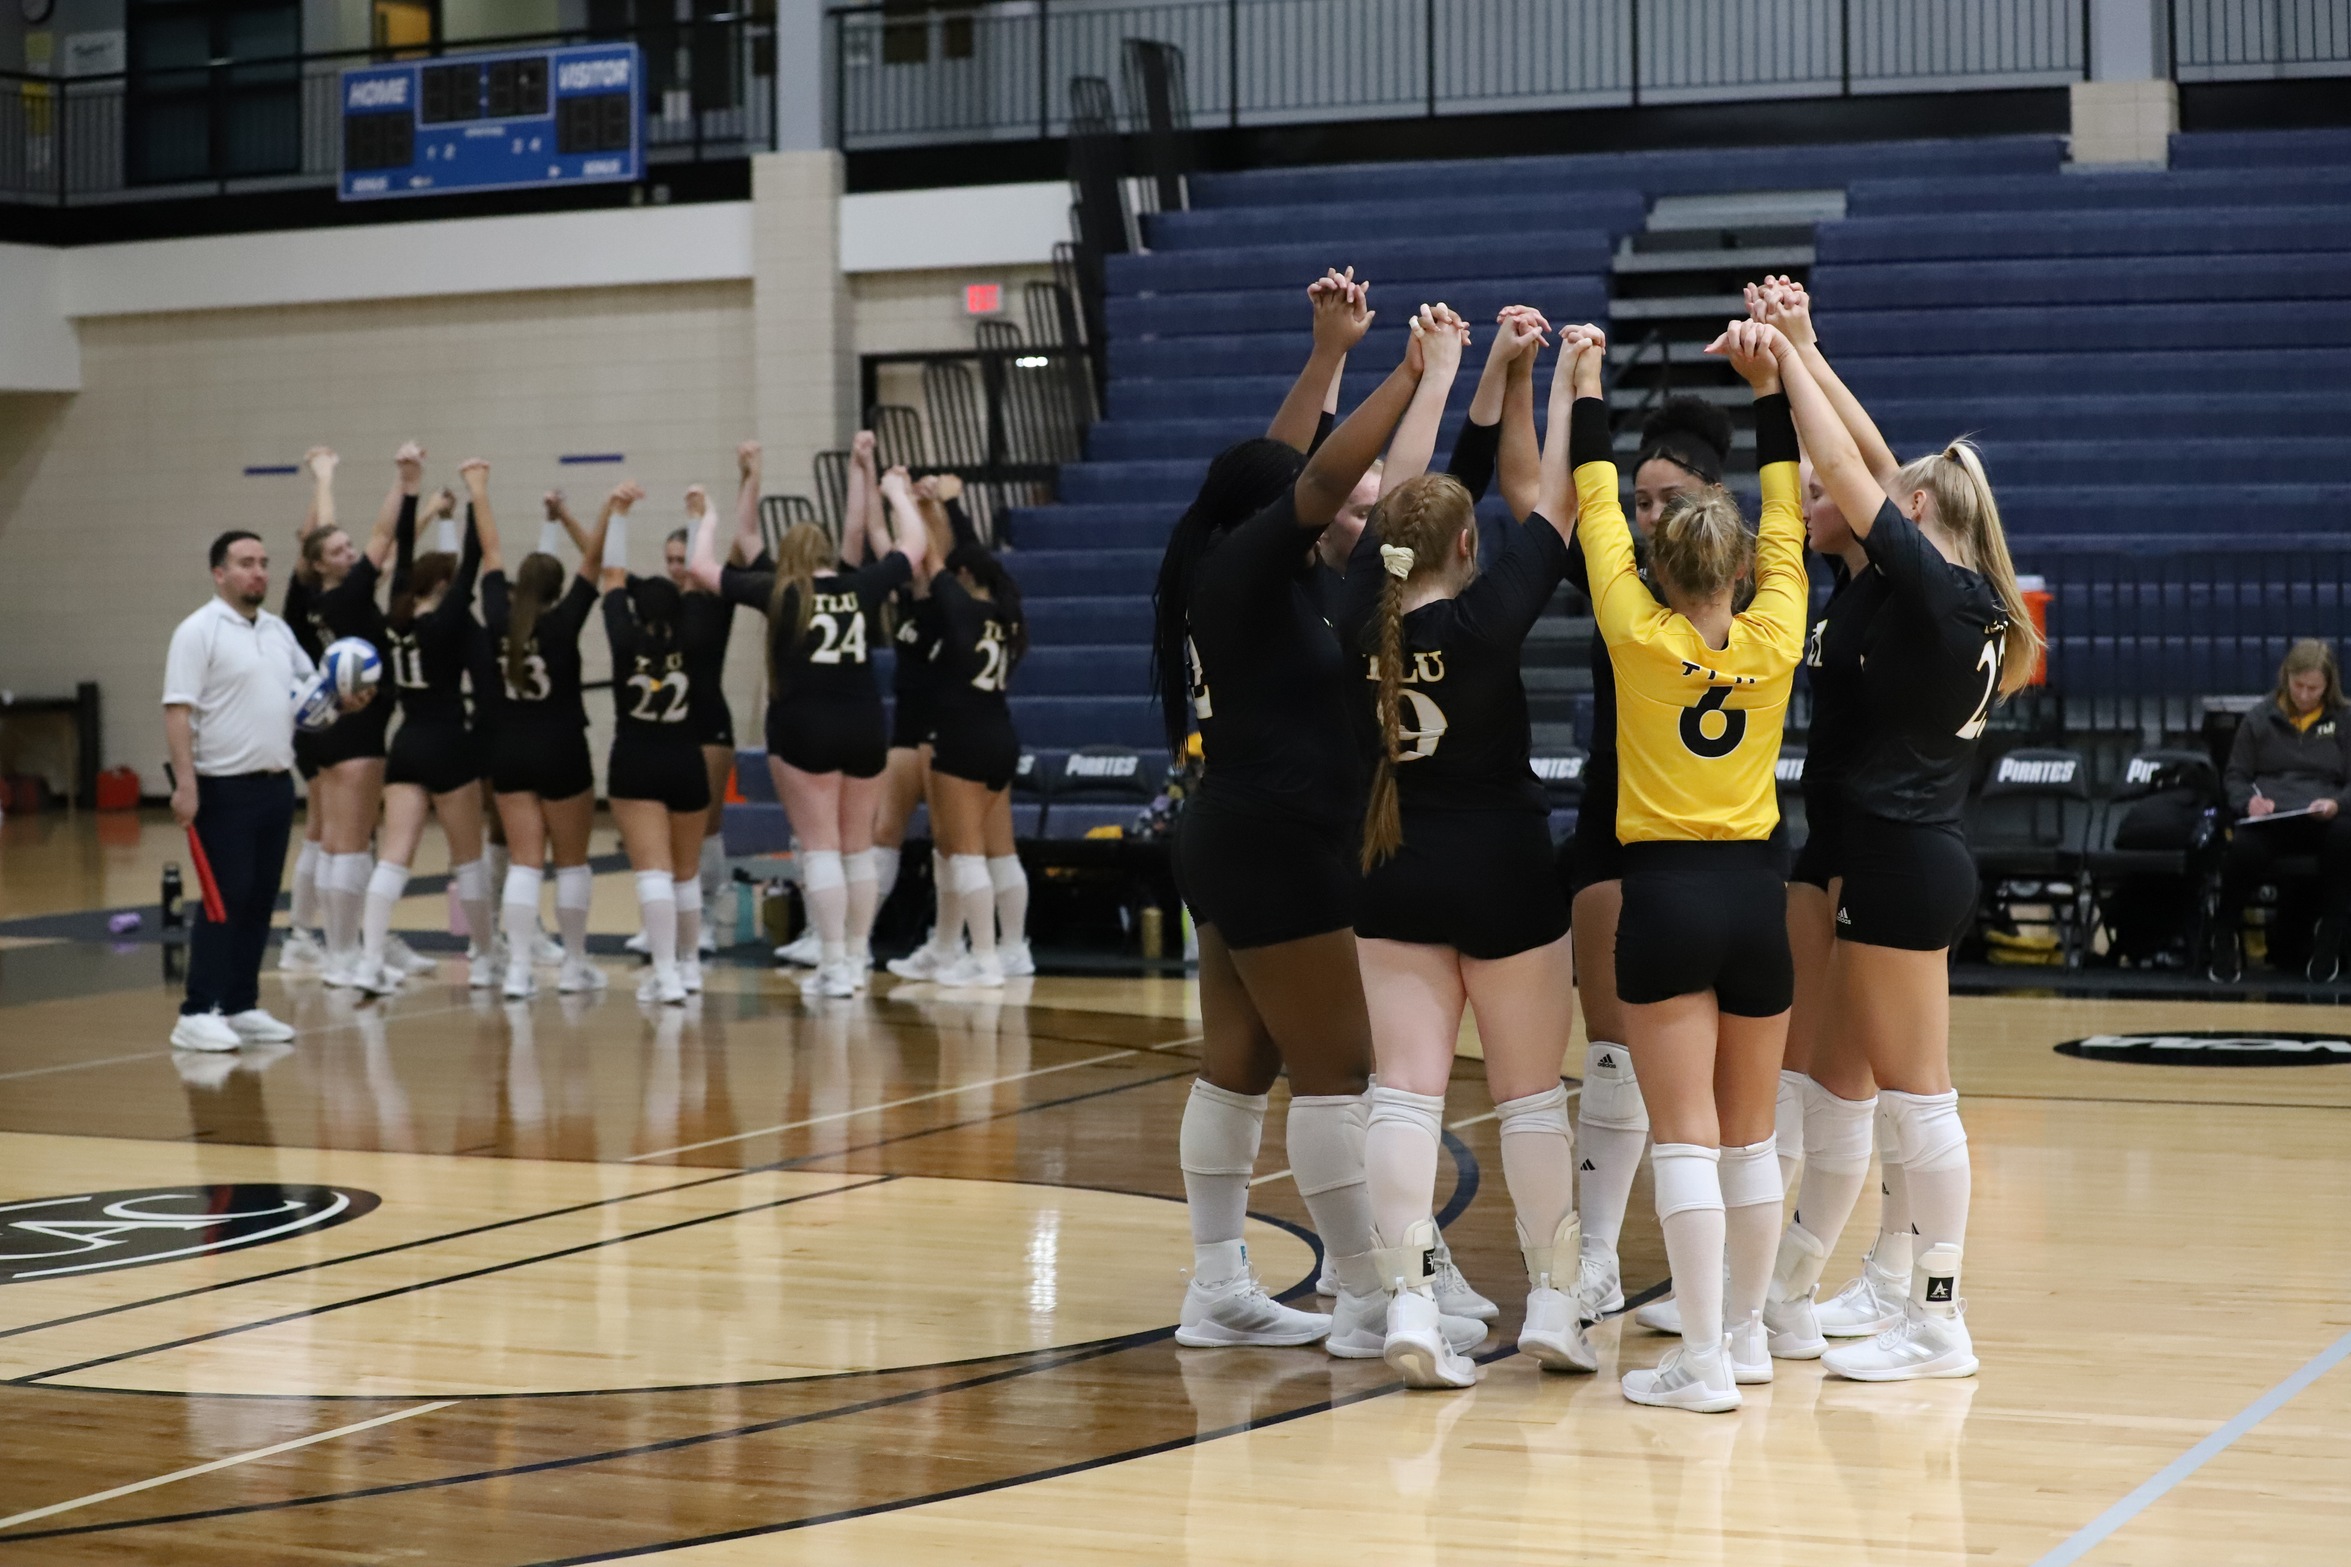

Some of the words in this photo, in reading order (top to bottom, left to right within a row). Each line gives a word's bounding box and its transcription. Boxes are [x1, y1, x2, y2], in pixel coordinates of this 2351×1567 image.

[558, 59, 629, 90] VISITOR
[349, 77, 408, 106] HOME
[813, 592, 858, 613] TLU
[809, 611, 866, 664] 24
[984, 620, 1018, 641] TL
[635, 652, 683, 674] TU
[627, 671, 690, 722] 22
[1679, 685, 1747, 758] 6
[1998, 758, 2077, 783] PIRATES
